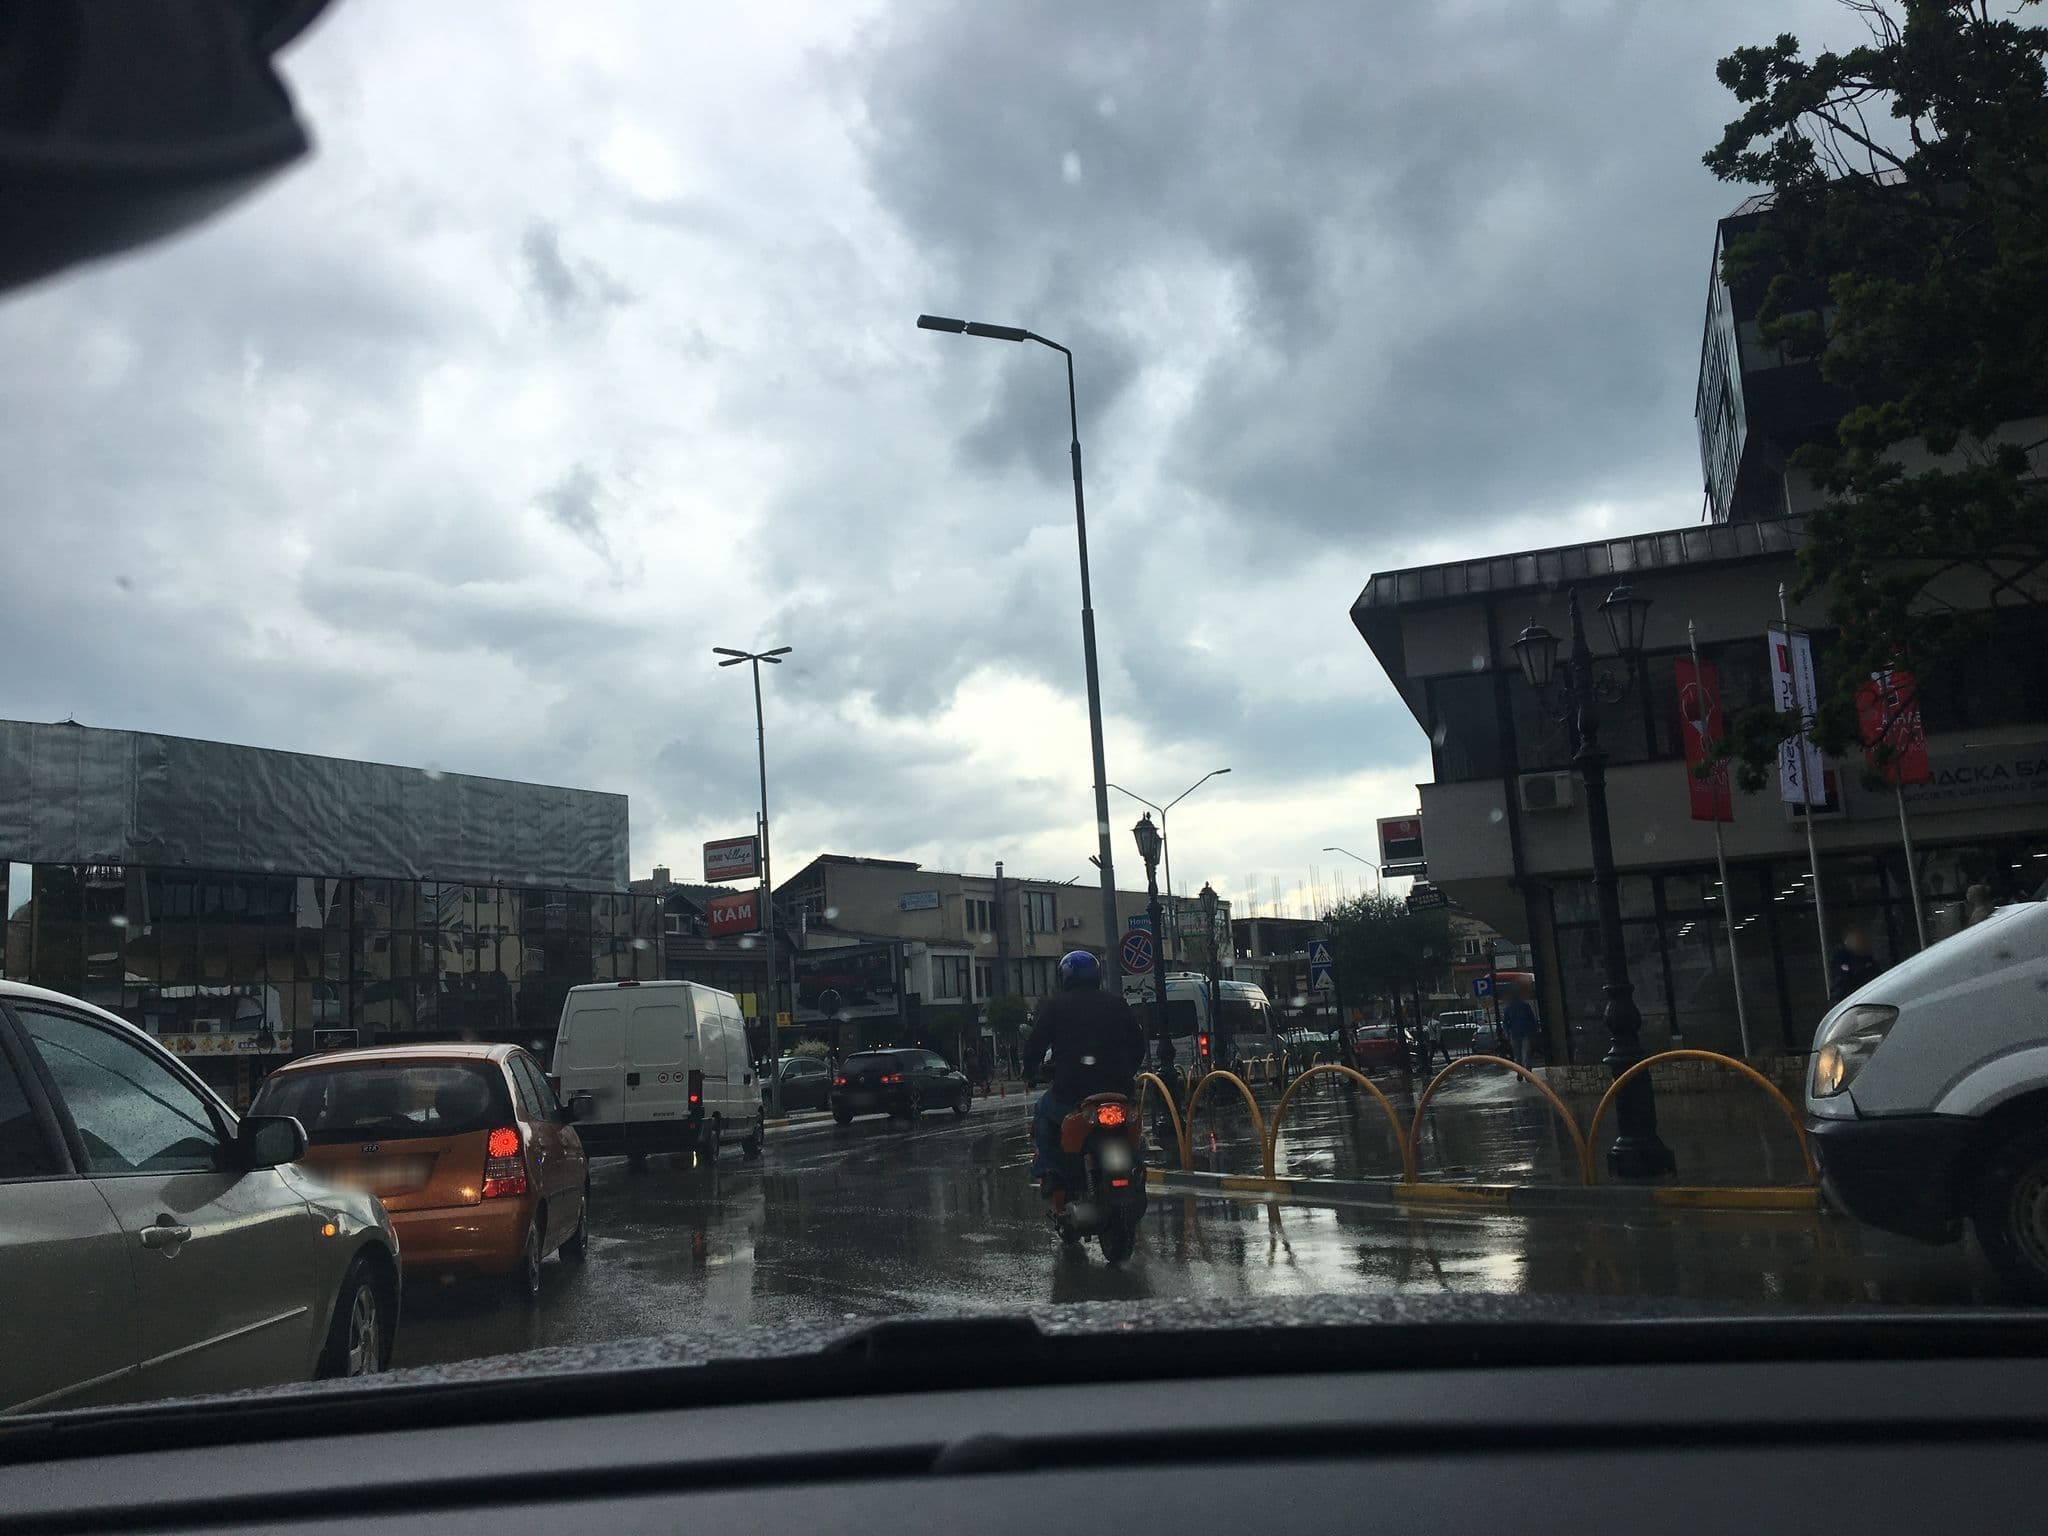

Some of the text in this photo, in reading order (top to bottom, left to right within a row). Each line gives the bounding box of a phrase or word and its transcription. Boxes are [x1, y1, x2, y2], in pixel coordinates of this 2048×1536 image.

[724, 847, 751, 863] Village
[712, 904, 752, 923] KAM
[1477, 980, 1488, 994] P
